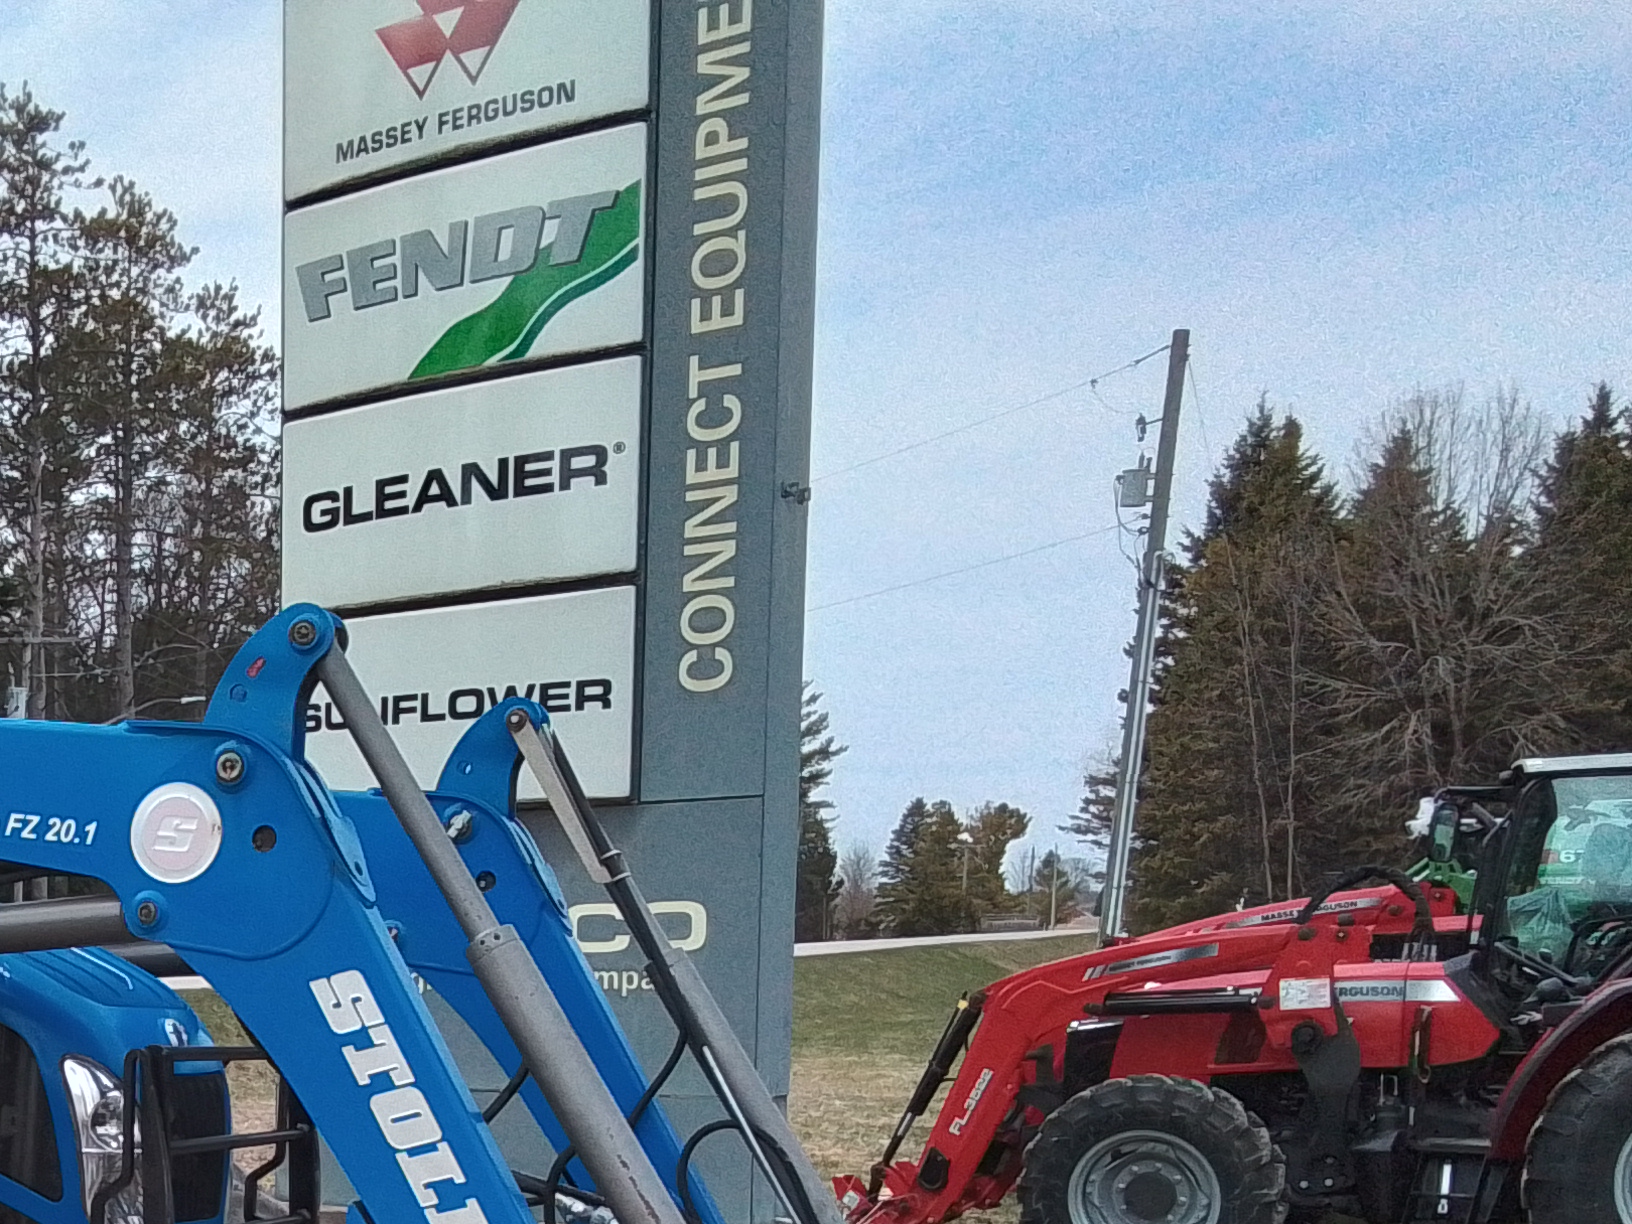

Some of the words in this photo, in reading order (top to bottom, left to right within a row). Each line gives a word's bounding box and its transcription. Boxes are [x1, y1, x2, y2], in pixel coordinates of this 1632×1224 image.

[335, 116, 429, 164] MASSEY
[437, 79, 576, 135] FERGUSON
[691, 0, 752, 334] EQUIPME
[295, 189, 621, 323] FENDT
[678, 354, 743, 693] CONNECT
[4, 812, 41, 840] FZ
[44, 816, 98, 846] 20.1
[1261, 909, 1300, 922] MASSE
[1336, 986, 1405, 998] RGUSON
